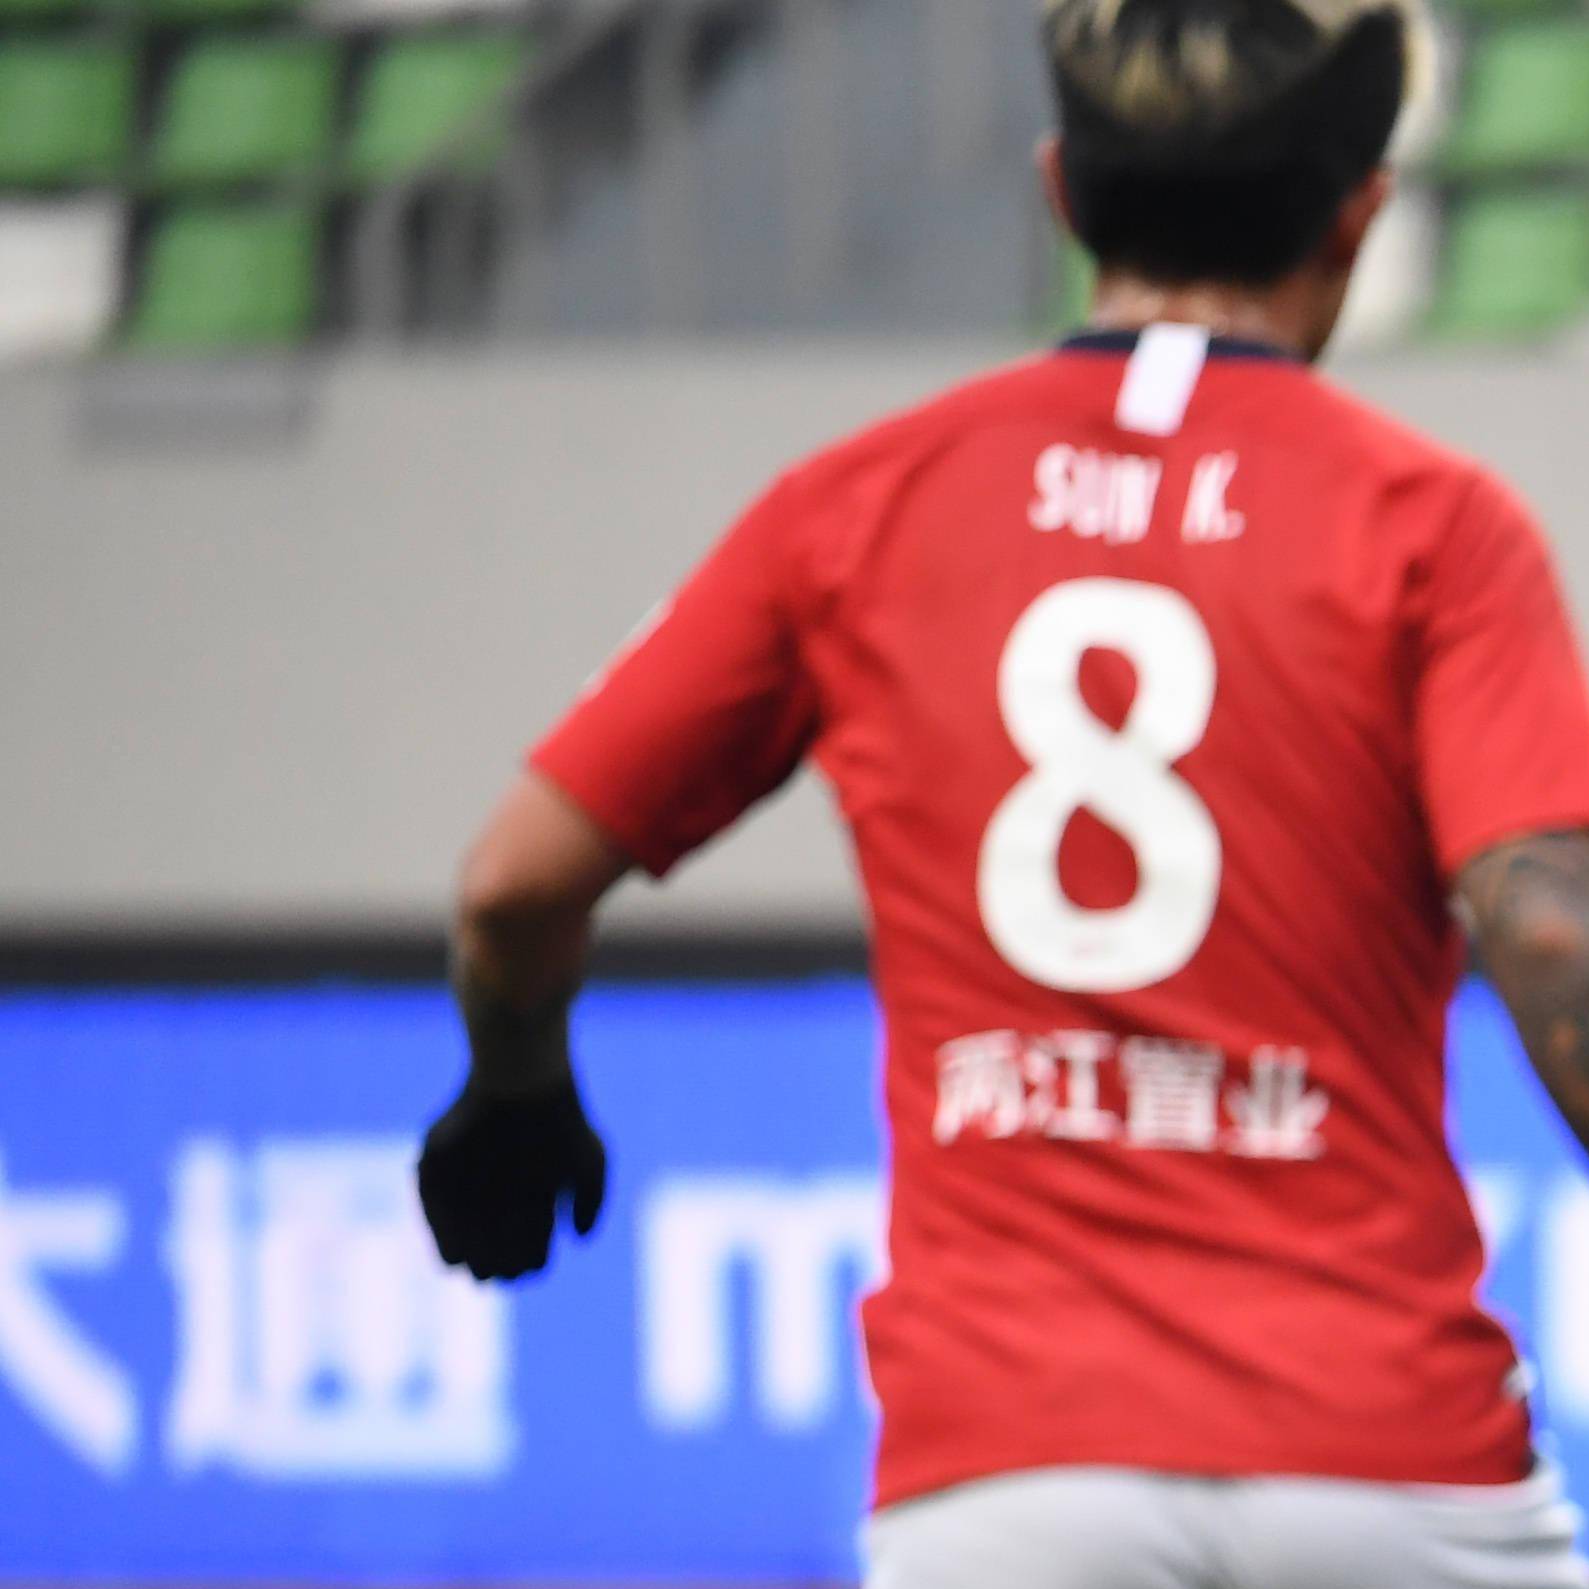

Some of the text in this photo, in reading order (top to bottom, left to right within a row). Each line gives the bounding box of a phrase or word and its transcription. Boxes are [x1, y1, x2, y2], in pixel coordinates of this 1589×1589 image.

[1027, 442, 1164, 544] SUN
[976, 575, 1223, 994] 8
[932, 1028, 1331, 1161] 两江置业
